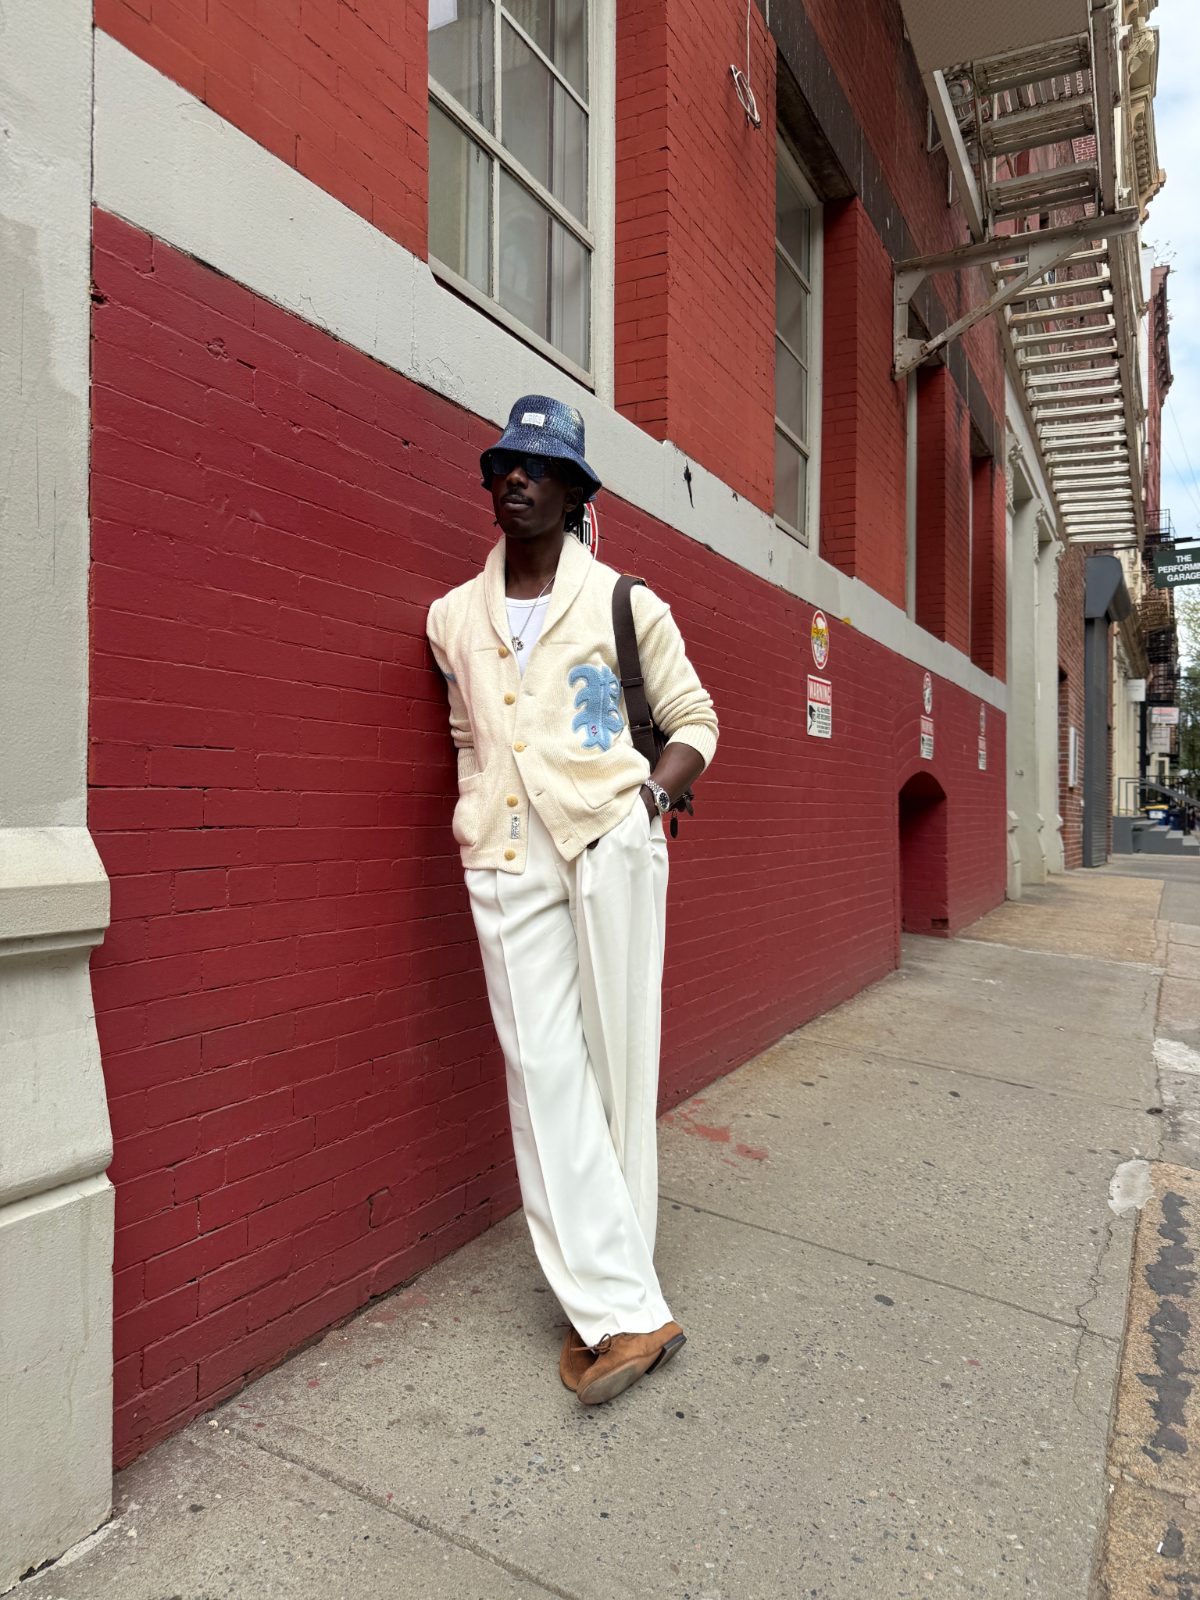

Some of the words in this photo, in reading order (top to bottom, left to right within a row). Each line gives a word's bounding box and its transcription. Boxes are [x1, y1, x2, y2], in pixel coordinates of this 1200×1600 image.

[1176, 554, 1192, 563] THE
[1158, 562, 1200, 574] PERFORMI
[1167, 571, 1200, 582] GARAGE
